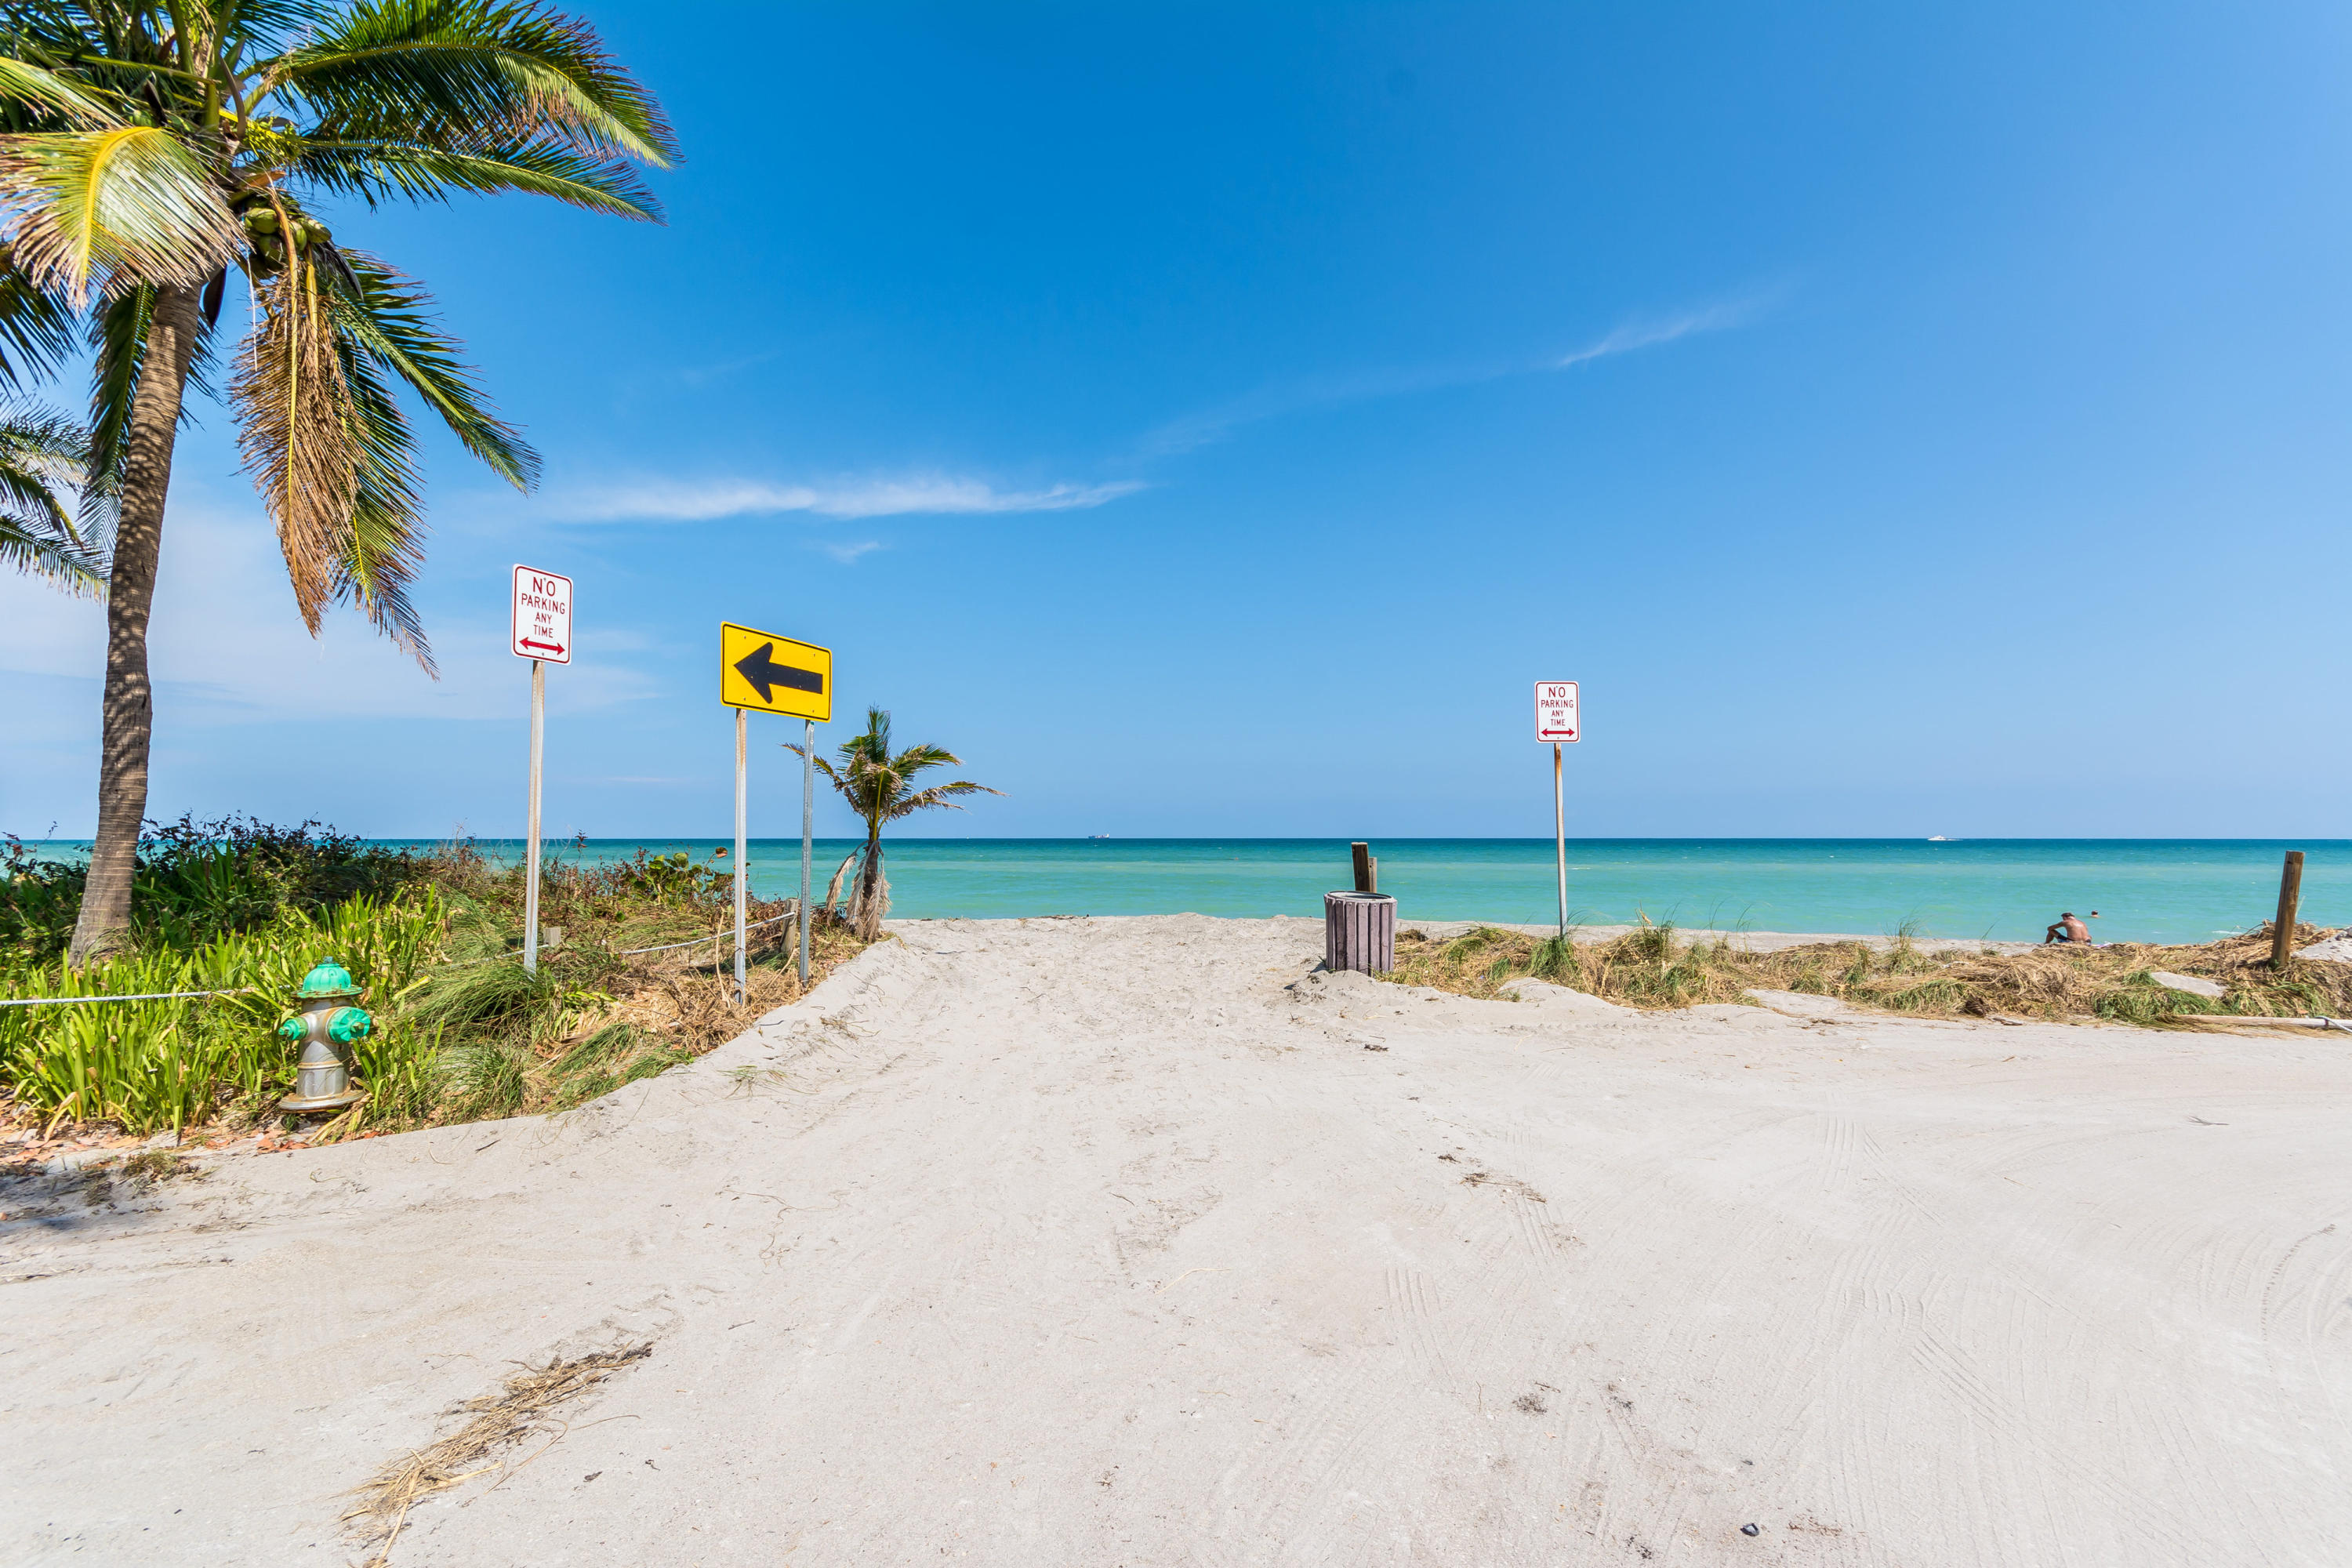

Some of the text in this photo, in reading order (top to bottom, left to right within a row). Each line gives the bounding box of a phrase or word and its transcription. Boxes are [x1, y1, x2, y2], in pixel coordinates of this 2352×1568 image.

[533, 576, 556, 597] NO
[521, 593, 566, 615] PARKING
[535, 612, 553, 625] ANY
[533, 624, 554, 639] TIME
[1548, 687, 1566, 698] NO
[1541, 699, 1574, 708] PARKING
